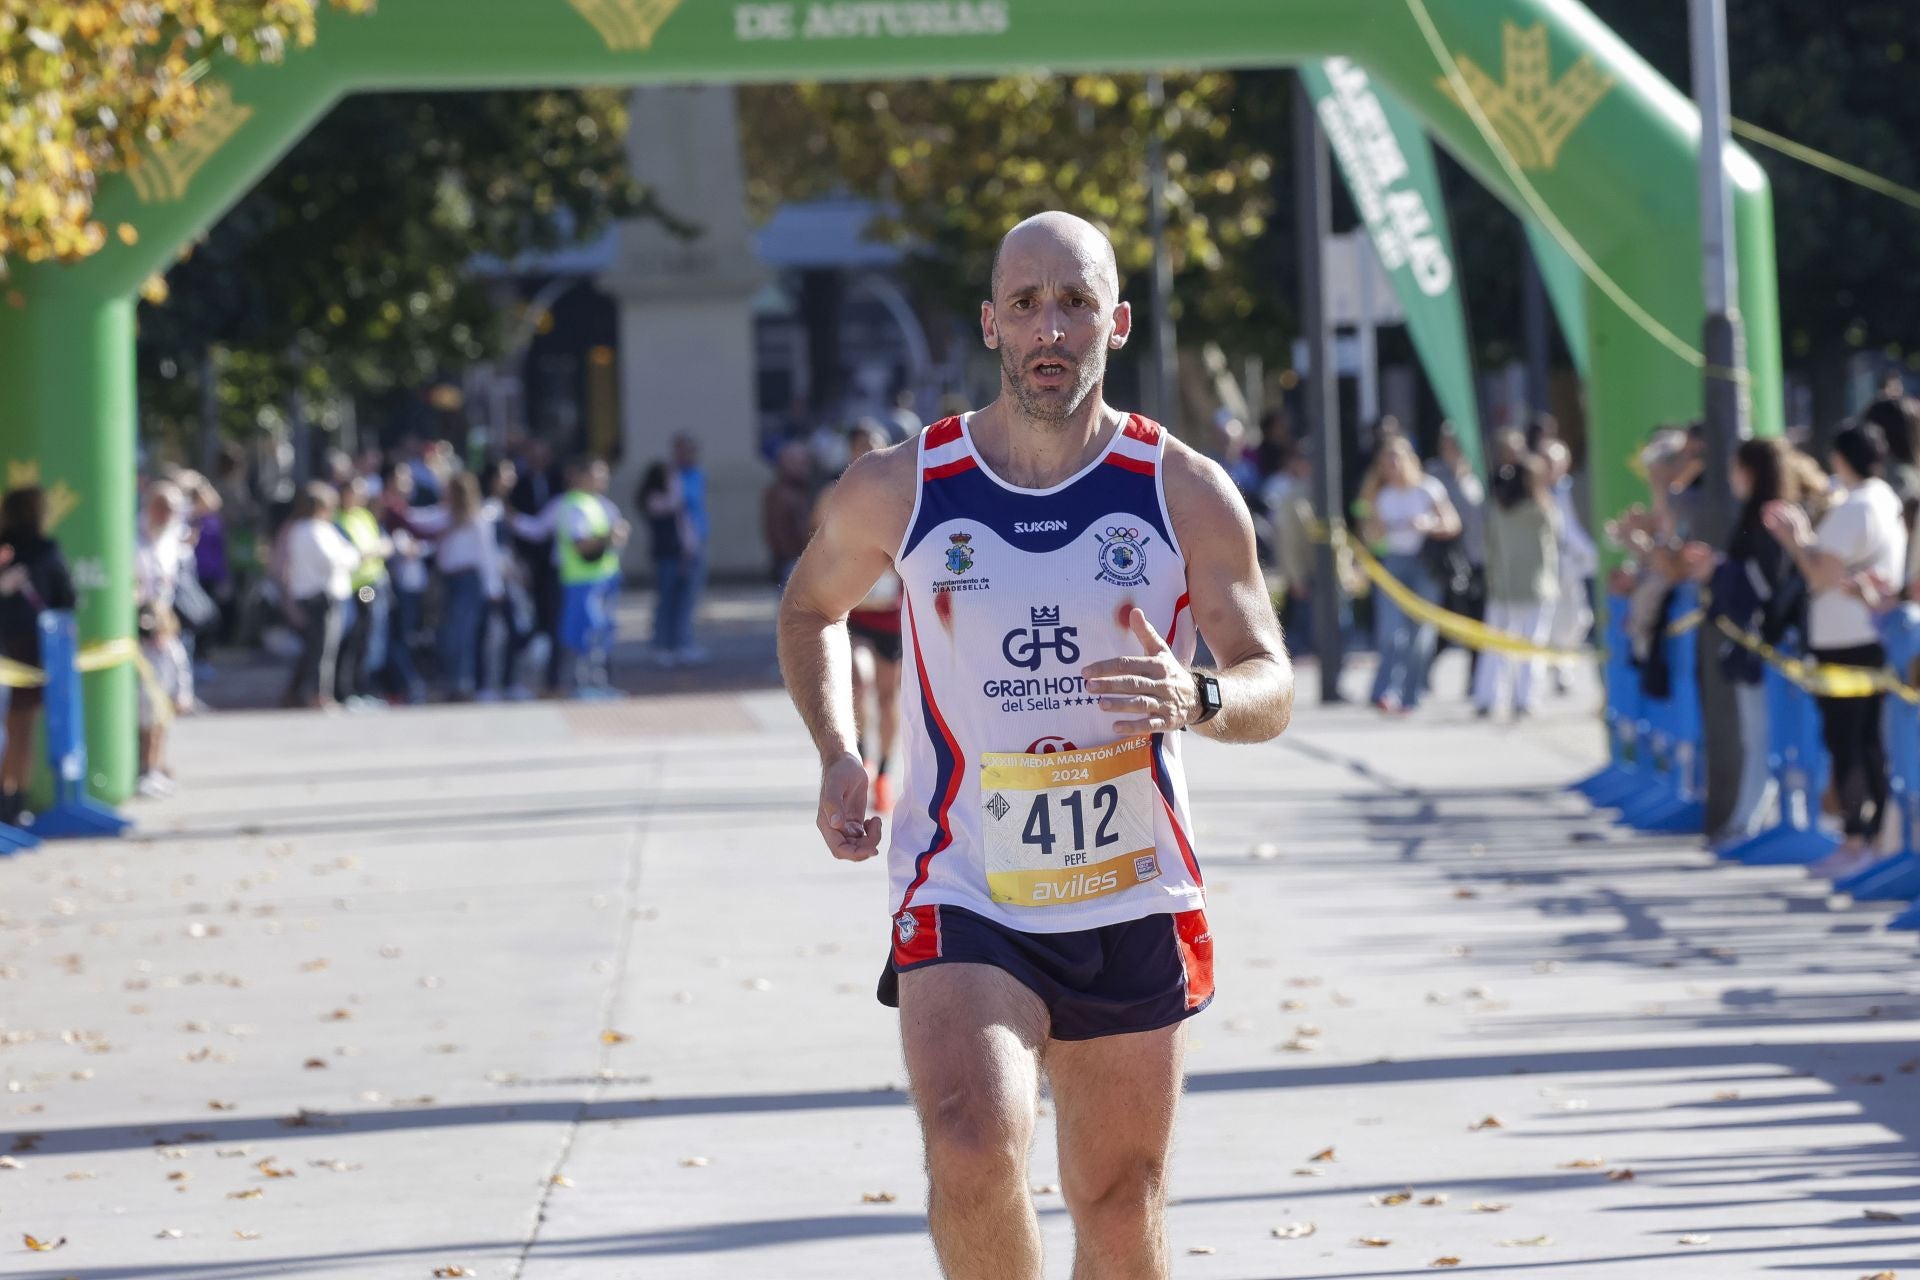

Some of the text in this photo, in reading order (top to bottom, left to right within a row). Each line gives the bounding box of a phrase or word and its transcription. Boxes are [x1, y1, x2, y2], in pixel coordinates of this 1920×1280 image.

[735, 2, 1009, 40] DE ASTURIAS
[1013, 520, 1067, 533] SUKAN
[932, 579, 978, 587] Ayuntamiento
[932, 584, 990, 593] RIBADESELLA
[1044, 676, 1087, 694] HOT
[1002, 697, 1060, 712] del Sella
[1021, 757, 1054, 768] MEDIA
[1057, 747, 1113, 765] MARATÓN
[1115, 736, 1147, 755] AVILÉS
[1051, 768, 1089, 782] 2024
[1021, 784, 1119, 855] 412
[1064, 852, 1088, 867] PEPE
[1032, 870, 1118, 900] avilés
